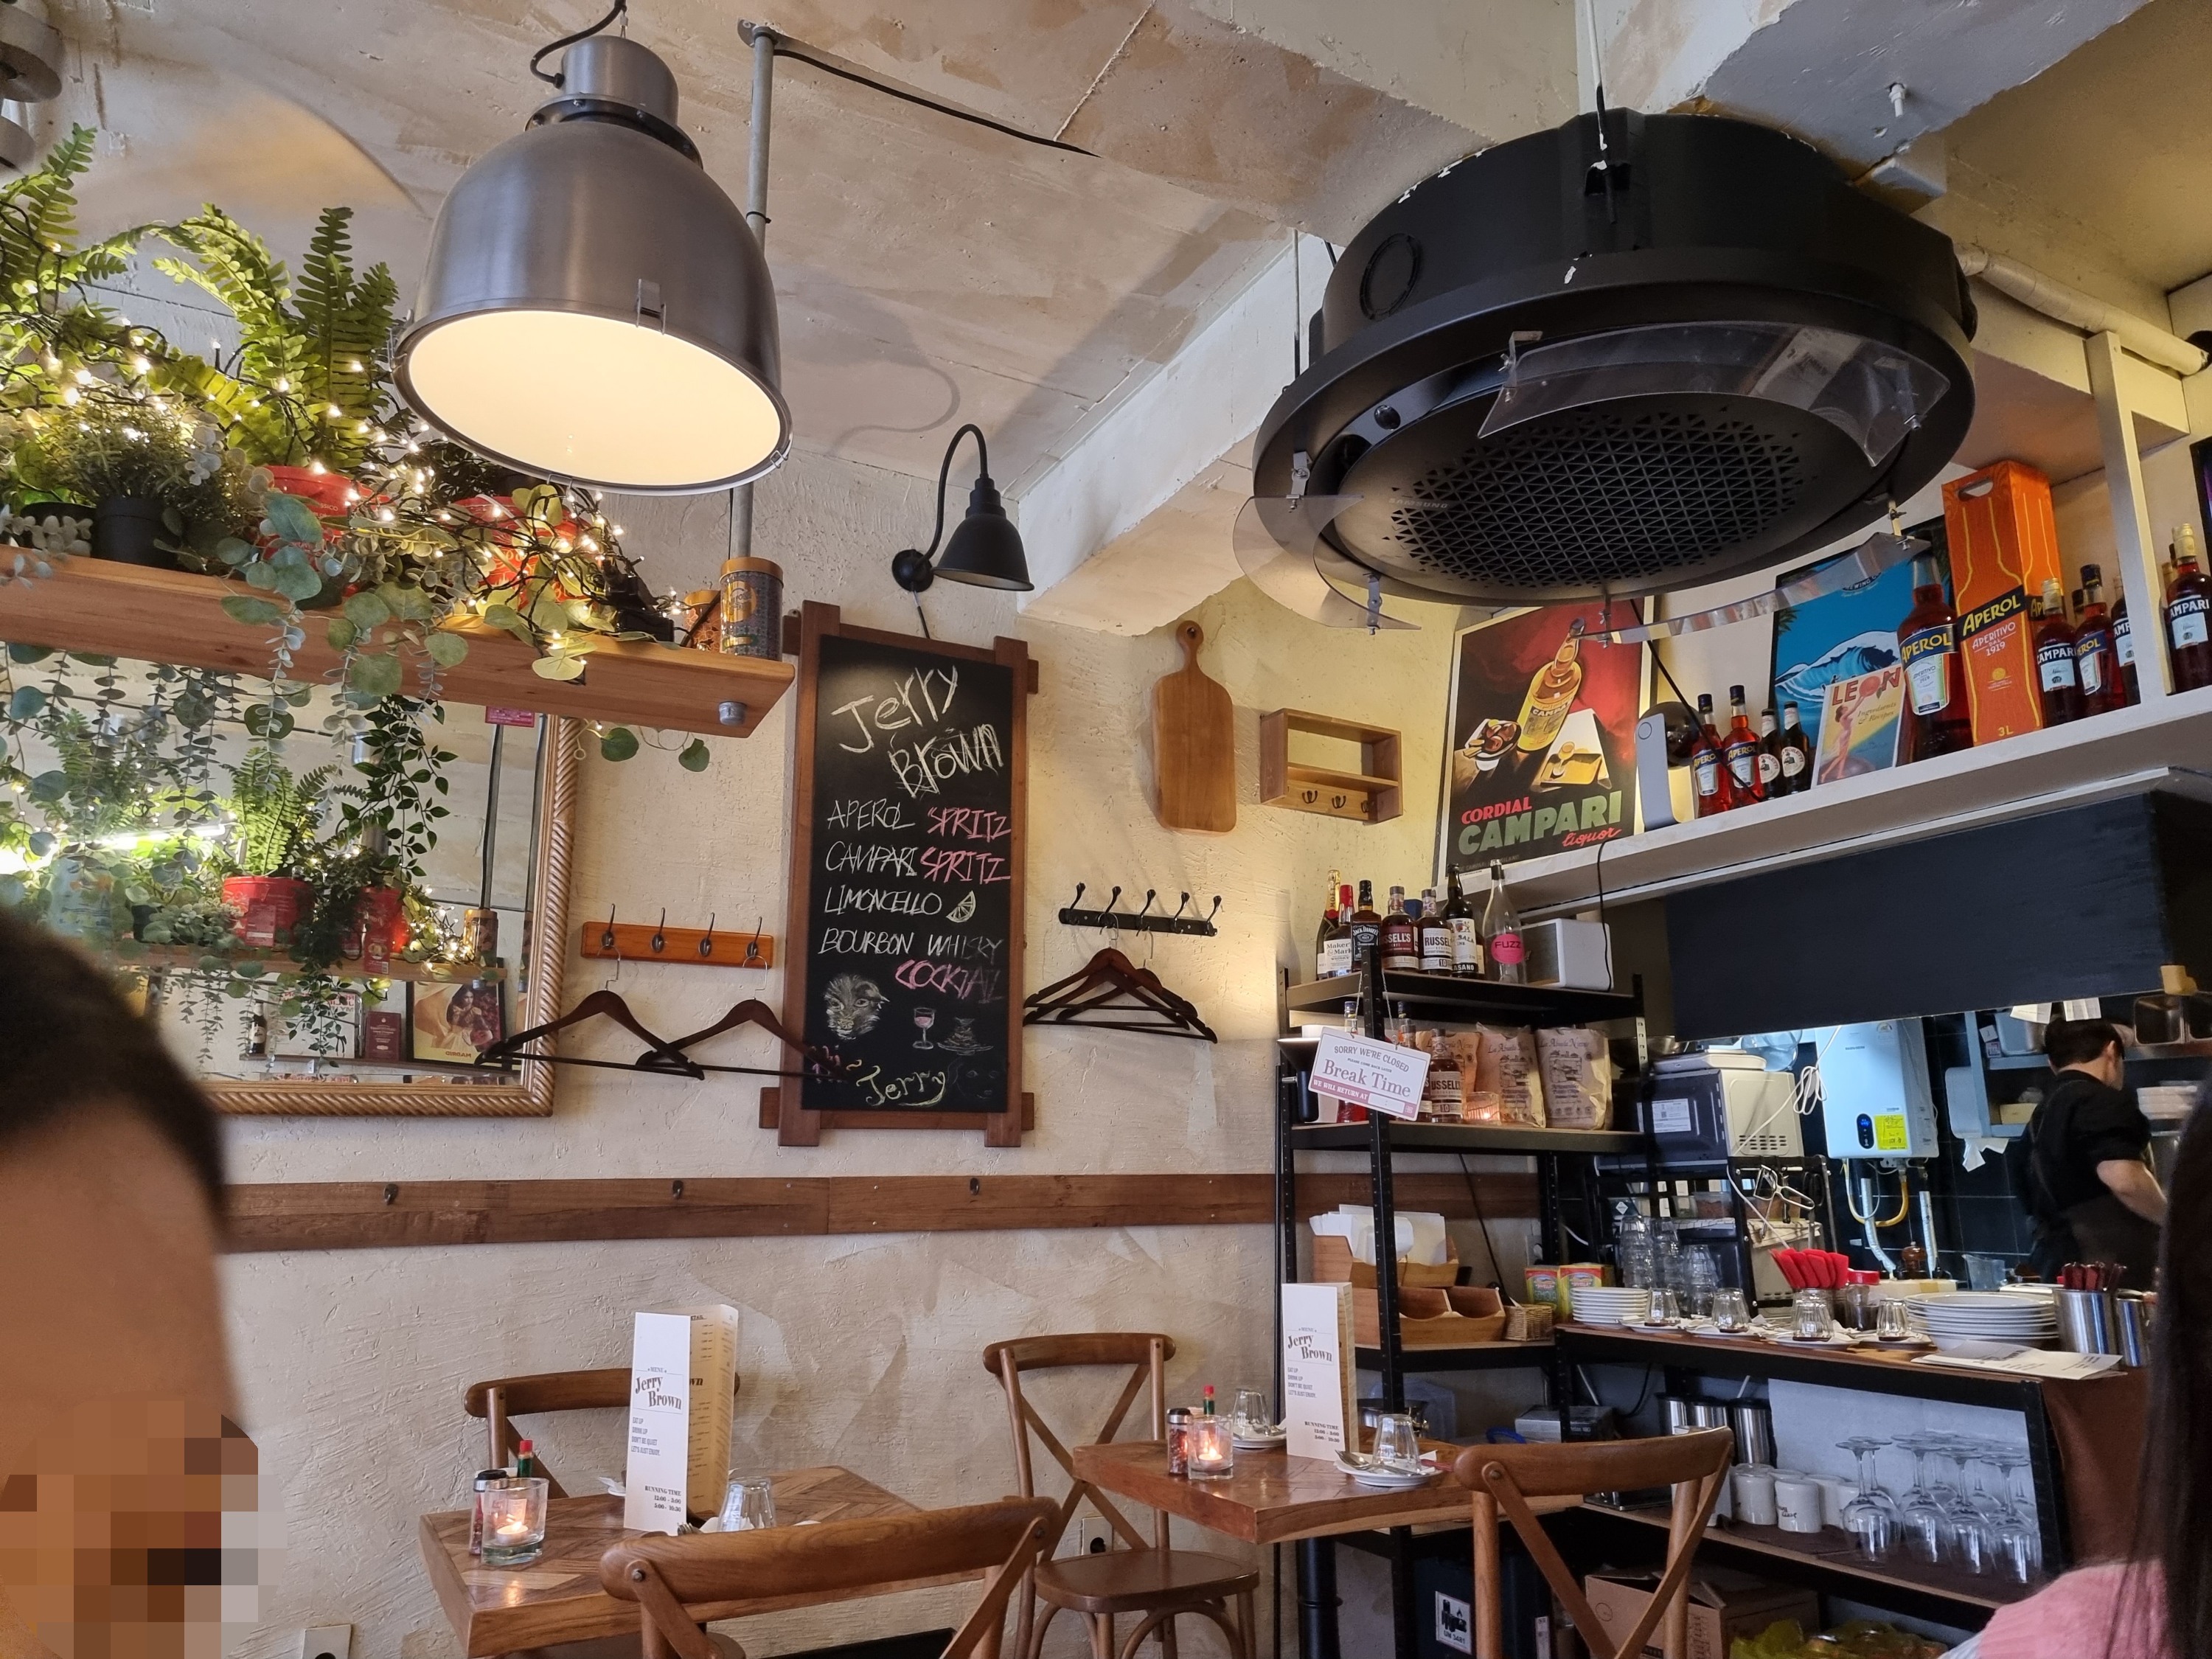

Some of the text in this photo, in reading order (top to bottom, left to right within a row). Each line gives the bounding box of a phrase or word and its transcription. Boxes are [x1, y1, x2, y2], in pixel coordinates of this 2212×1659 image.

[1389, 498, 1449, 509] SAMSUNG
[1962, 595, 2021, 637] APEROL
[2170, 599, 2210, 618] AMPARI
[1902, 633, 1952, 663] APEROL
[1972, 622, 2016, 650] APERITIVO
[2077, 638, 2101, 655] EROL
[1986, 641, 2006, 657] 1919
[831, 665, 959, 754] Jerry
[1998, 725, 2014, 737] 3L
[887, 724, 1004, 798] Brown
[1694, 753, 1717, 768] APERO
[827, 799, 1012, 842] APEROL SPRITZ
[1461, 796, 1532, 824] CORDIAL
[1458, 790, 1622, 855] CAMPARI
[1562, 827, 1621, 847] liquor
[825, 841, 1011, 884] CAMPARI SPRITZ
[824, 885, 943, 916] LIMONCELLO
[818, 928, 915, 955] BOURBON
[1495, 941, 1521, 949] FUZZ
[894, 959, 1006, 1004] COCKTAIL
[1334, 1046, 1410, 1073] SORRY WE'RE CLOSED
[856, 1065, 945, 1106] Jerry
[1313, 1079, 1322, 1087] WE
[1323, 1082, 1337, 1092] WILL
[1337, 1085, 1360, 1098] RETURN
[1323, 1058, 1367, 1086] Break
[1371, 1071, 1411, 1097] Time
[1287, 1335, 1314, 1349] Jerry
[1301, 1346, 1332, 1362] Brown
[635, 1376, 664, 1394] Jerry
[647, 1390, 682, 1411] Brown
[1304, 1421, 1327, 1429] RUNNING
[644, 1485, 668, 1494] RUNNING
